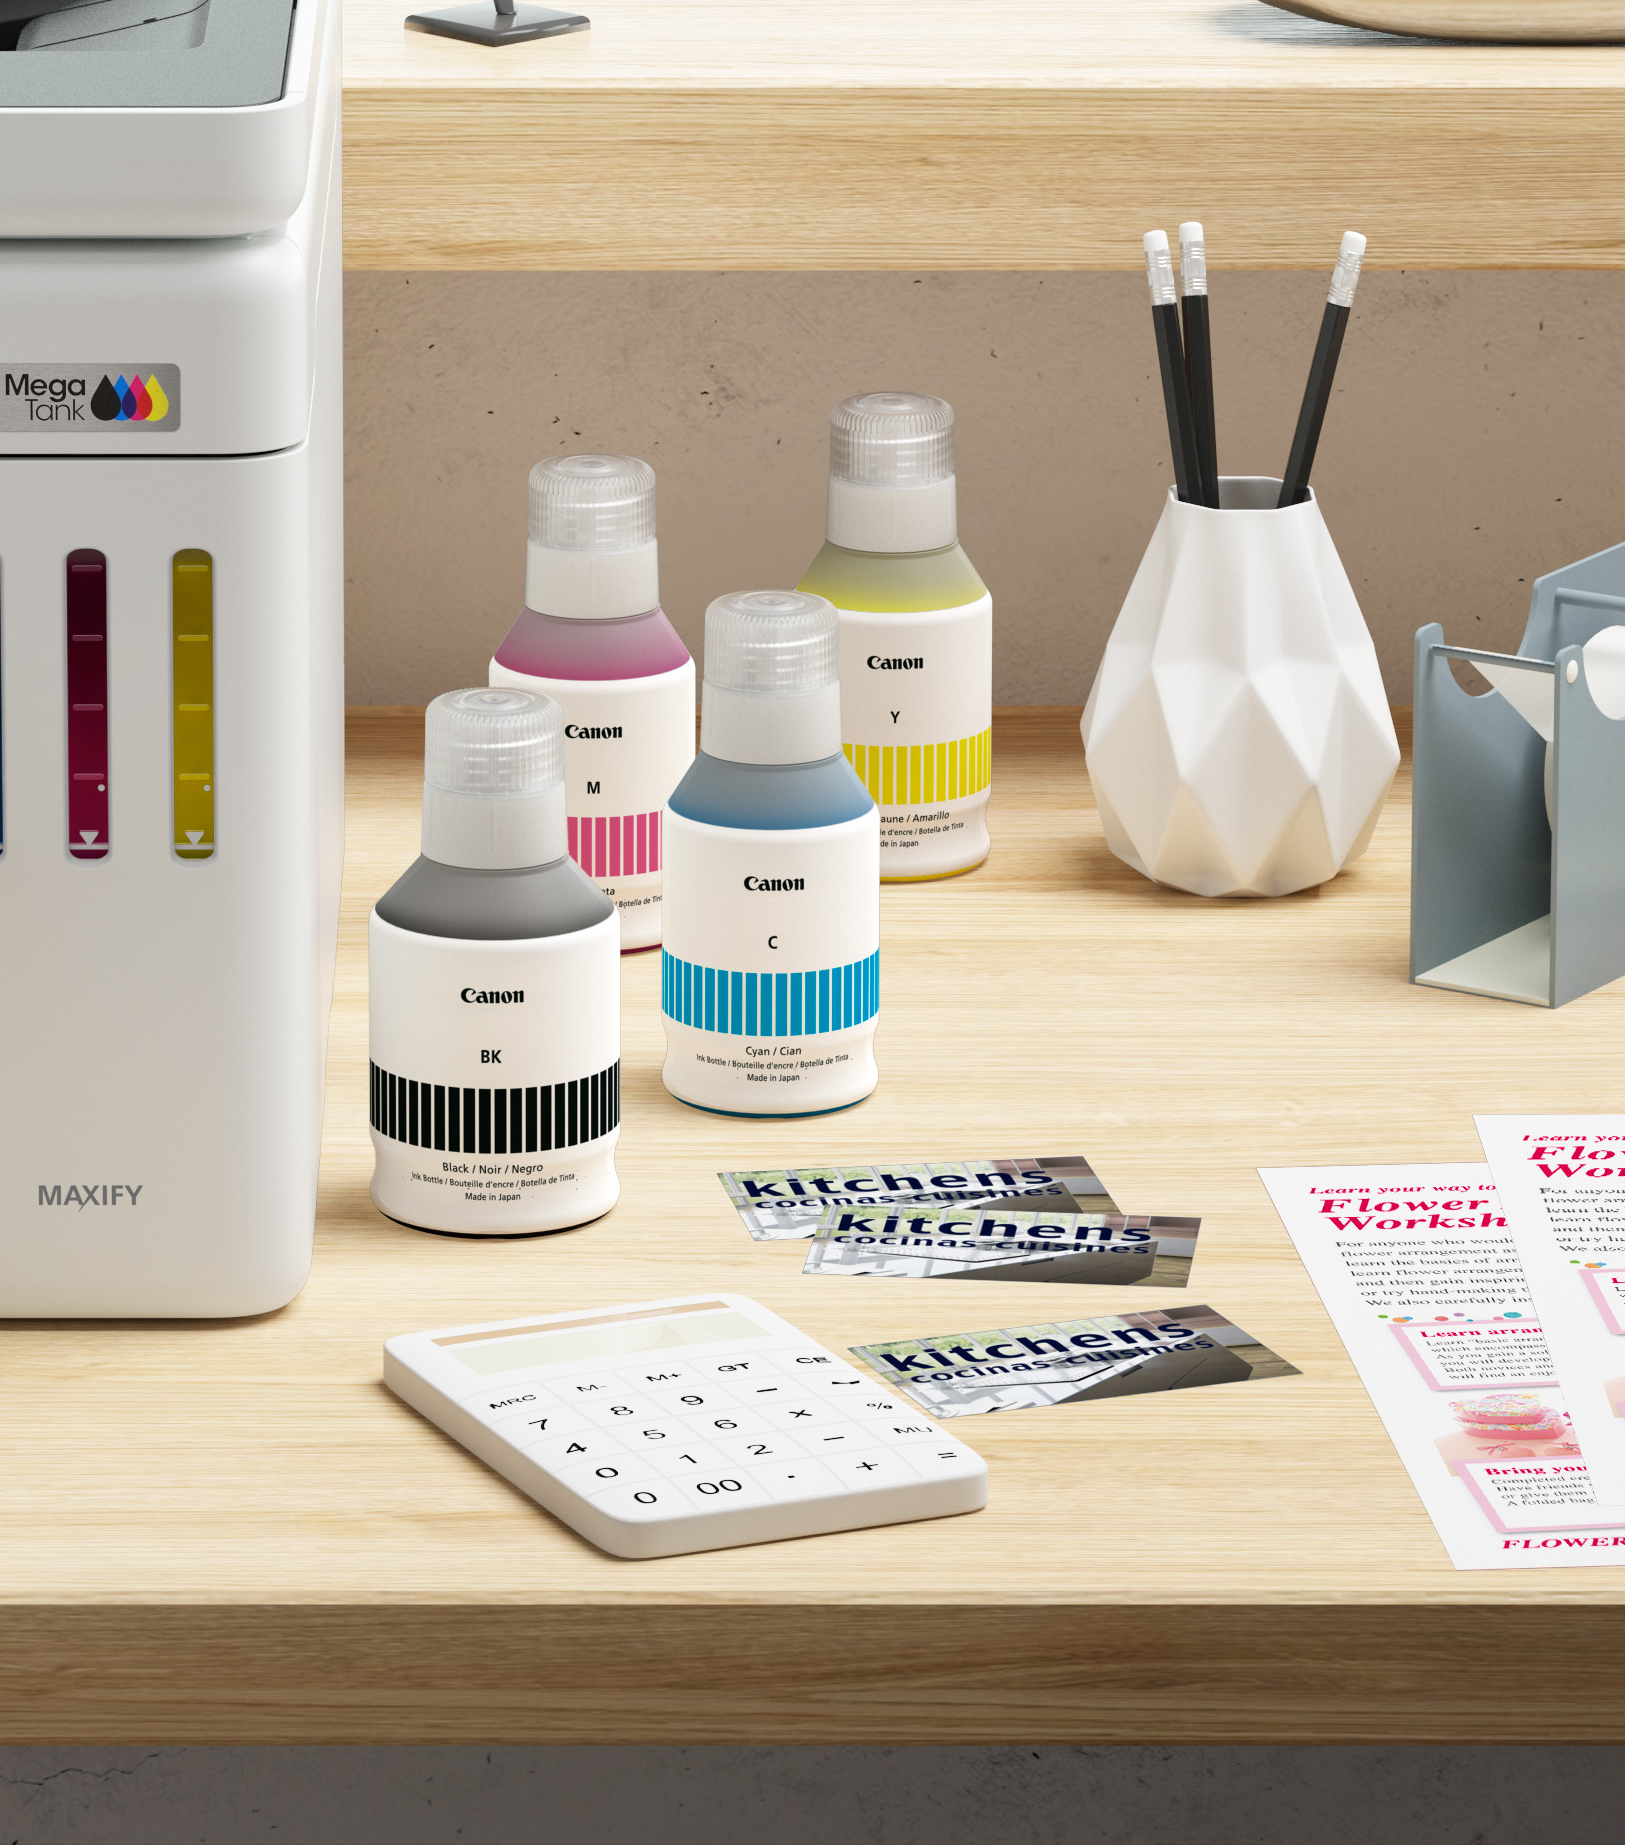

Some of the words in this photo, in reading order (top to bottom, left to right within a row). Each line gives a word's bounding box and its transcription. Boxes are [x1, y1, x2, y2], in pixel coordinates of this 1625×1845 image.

[5, 373, 86, 402] Mega
[24, 398, 85, 421] Tank
[867, 655, 924, 670] Canon
[890, 710, 900, 723] Y
[564, 724, 623, 739] Canon
[586, 781, 601, 794] M
[912, 811, 950, 823] Amarillo
[887, 827, 913, 836] d'encre
[918, 825, 941, 835] Botella
[942, 824, 950, 832] de
[951, 821, 964, 831] Tinta
[890, 839, 898, 847] in
[899, 839, 919, 848] Japan
[743, 875, 805, 891] Canon
[618, 898, 642, 908] Botella
[642, 896, 651, 904] de
[767, 935, 778, 949] C
[460, 987, 525, 1004] Canon
[481, 1049, 502, 1063] BK
[745, 1046, 770, 1057] Cyan
[780, 1046, 802, 1056] Cian
[696, 1053, 706, 1062] Ink
[706, 1055, 727, 1067] Bottle
[732, 1059, 765, 1069] Bouteille
[766, 1061, 794, 1069] d'encre
[800, 1058, 824, 1068] Botella
[825, 1057, 834, 1065] de
[834, 1053, 849, 1063] Tinta
[746, 1073, 768, 1082] Made
[769, 1073, 777, 1082] in
[779, 1073, 800, 1083] Japan
[442, 1162, 469, 1174] Black
[479, 1164, 502, 1174] Noir
[511, 1163, 544, 1176] Negro
[411, 1172, 422, 1181] Ink
[422, 1174, 444, 1185] Bottle
[449, 1178, 484, 1188] Bouteille
[485, 1179, 514, 1188] d'encre
[520, 1176, 547, 1188] Botella
[548, 1175, 558, 1184] de
[559, 1172, 575, 1183] Tinta
[741, 1169, 1054, 1198] kitchens
[37, 1184, 144, 1212] MAXIFY
[465, 1192, 487, 1201] Made
[488, 1192, 497, 1201] in
[498, 1192, 521, 1203] Japan
[755, 1193, 896, 1210] cocinas
[912, 1180, 1064, 1202] cuisines
[1308, 1187, 1371, 1195] Learn
[1376, 1186, 1426, 1195] your
[1432, 1185, 1472, 1194] way
[1318, 1198, 1490, 1214] Flower
[836, 1213, 1152, 1243] kitchens
[1324, 1212, 1508, 1231] Worksh
[833, 1234, 977, 1249] cocinas
[995, 1239, 1150, 1255] cuisines
[880, 1321, 1195, 1373] kitchens
[910, 1358, 1051, 1384] cocinas
[1064, 1336, 1215, 1366] cuisines
[488, 1393, 538, 1411] MRC
[646, 1371, 682, 1383] M+
[717, 1361, 751, 1373] GT
[528, 1418, 550, 1432] 7
[610, 1405, 634, 1416] 8
[680, 1394, 704, 1406] 9
[565, 1442, 588, 1454] 4
[642, 1428, 667, 1441] 5
[714, 1418, 739, 1431] 6
[595, 1467, 619, 1479] 0
[678, 1454, 699, 1465] 1
[746, 1443, 774, 1456] 2
[633, 1491, 658, 1505] 0
[696, 1478, 743, 1496] 00
